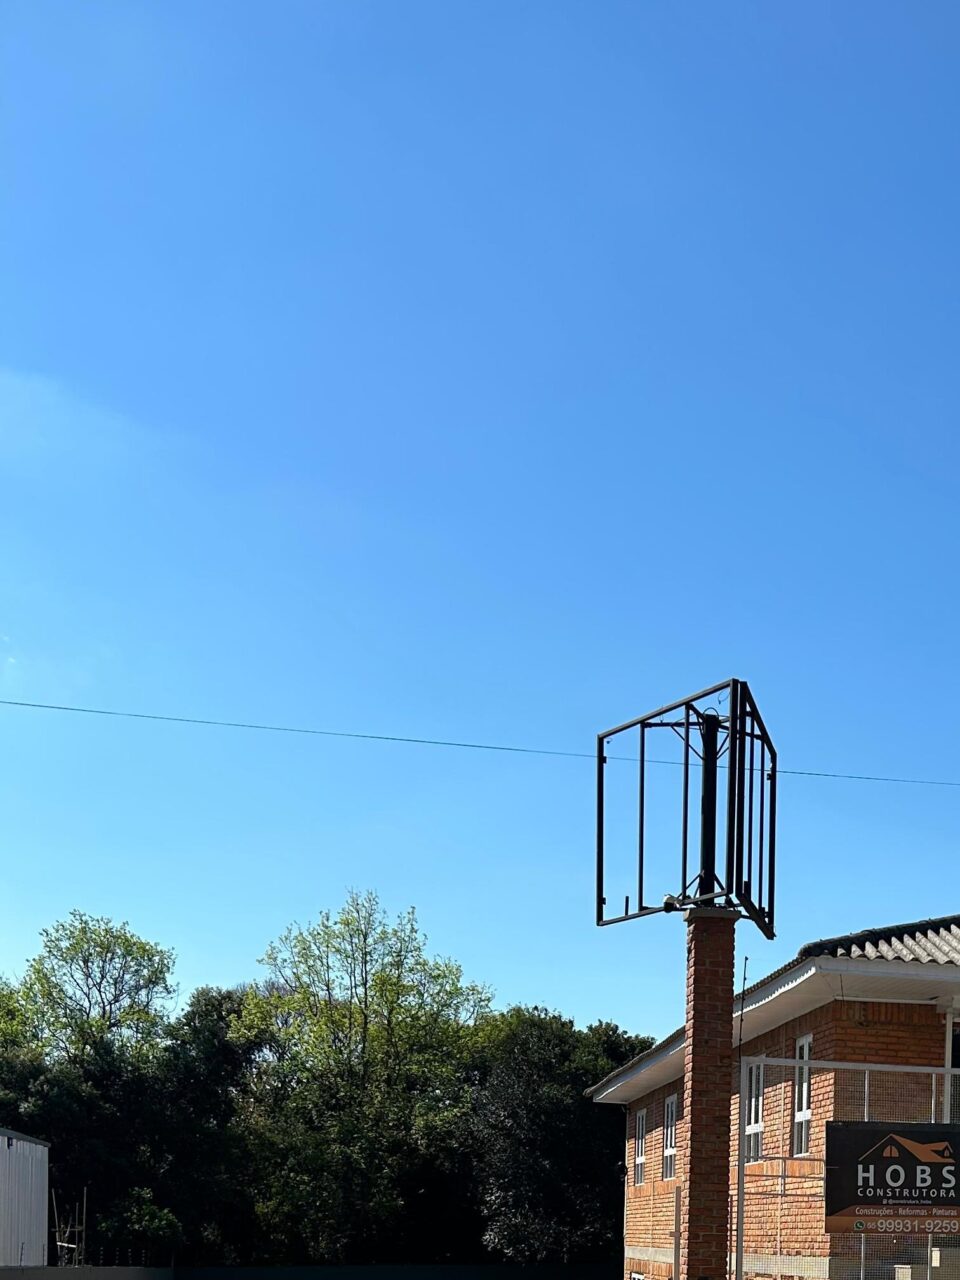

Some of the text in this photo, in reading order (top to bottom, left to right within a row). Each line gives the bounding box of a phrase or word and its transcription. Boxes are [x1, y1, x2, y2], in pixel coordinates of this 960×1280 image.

[857, 1164, 956, 1188] HOBS
[857, 1188, 956, 1198] CONSTRUTORA
[855, 1206, 893, 1216] Construções
[898, 1207, 928, 1216] Reformas
[932, 1208, 957, 1216] Pinturas
[877, 1219, 959, 1233] 99931-9259
